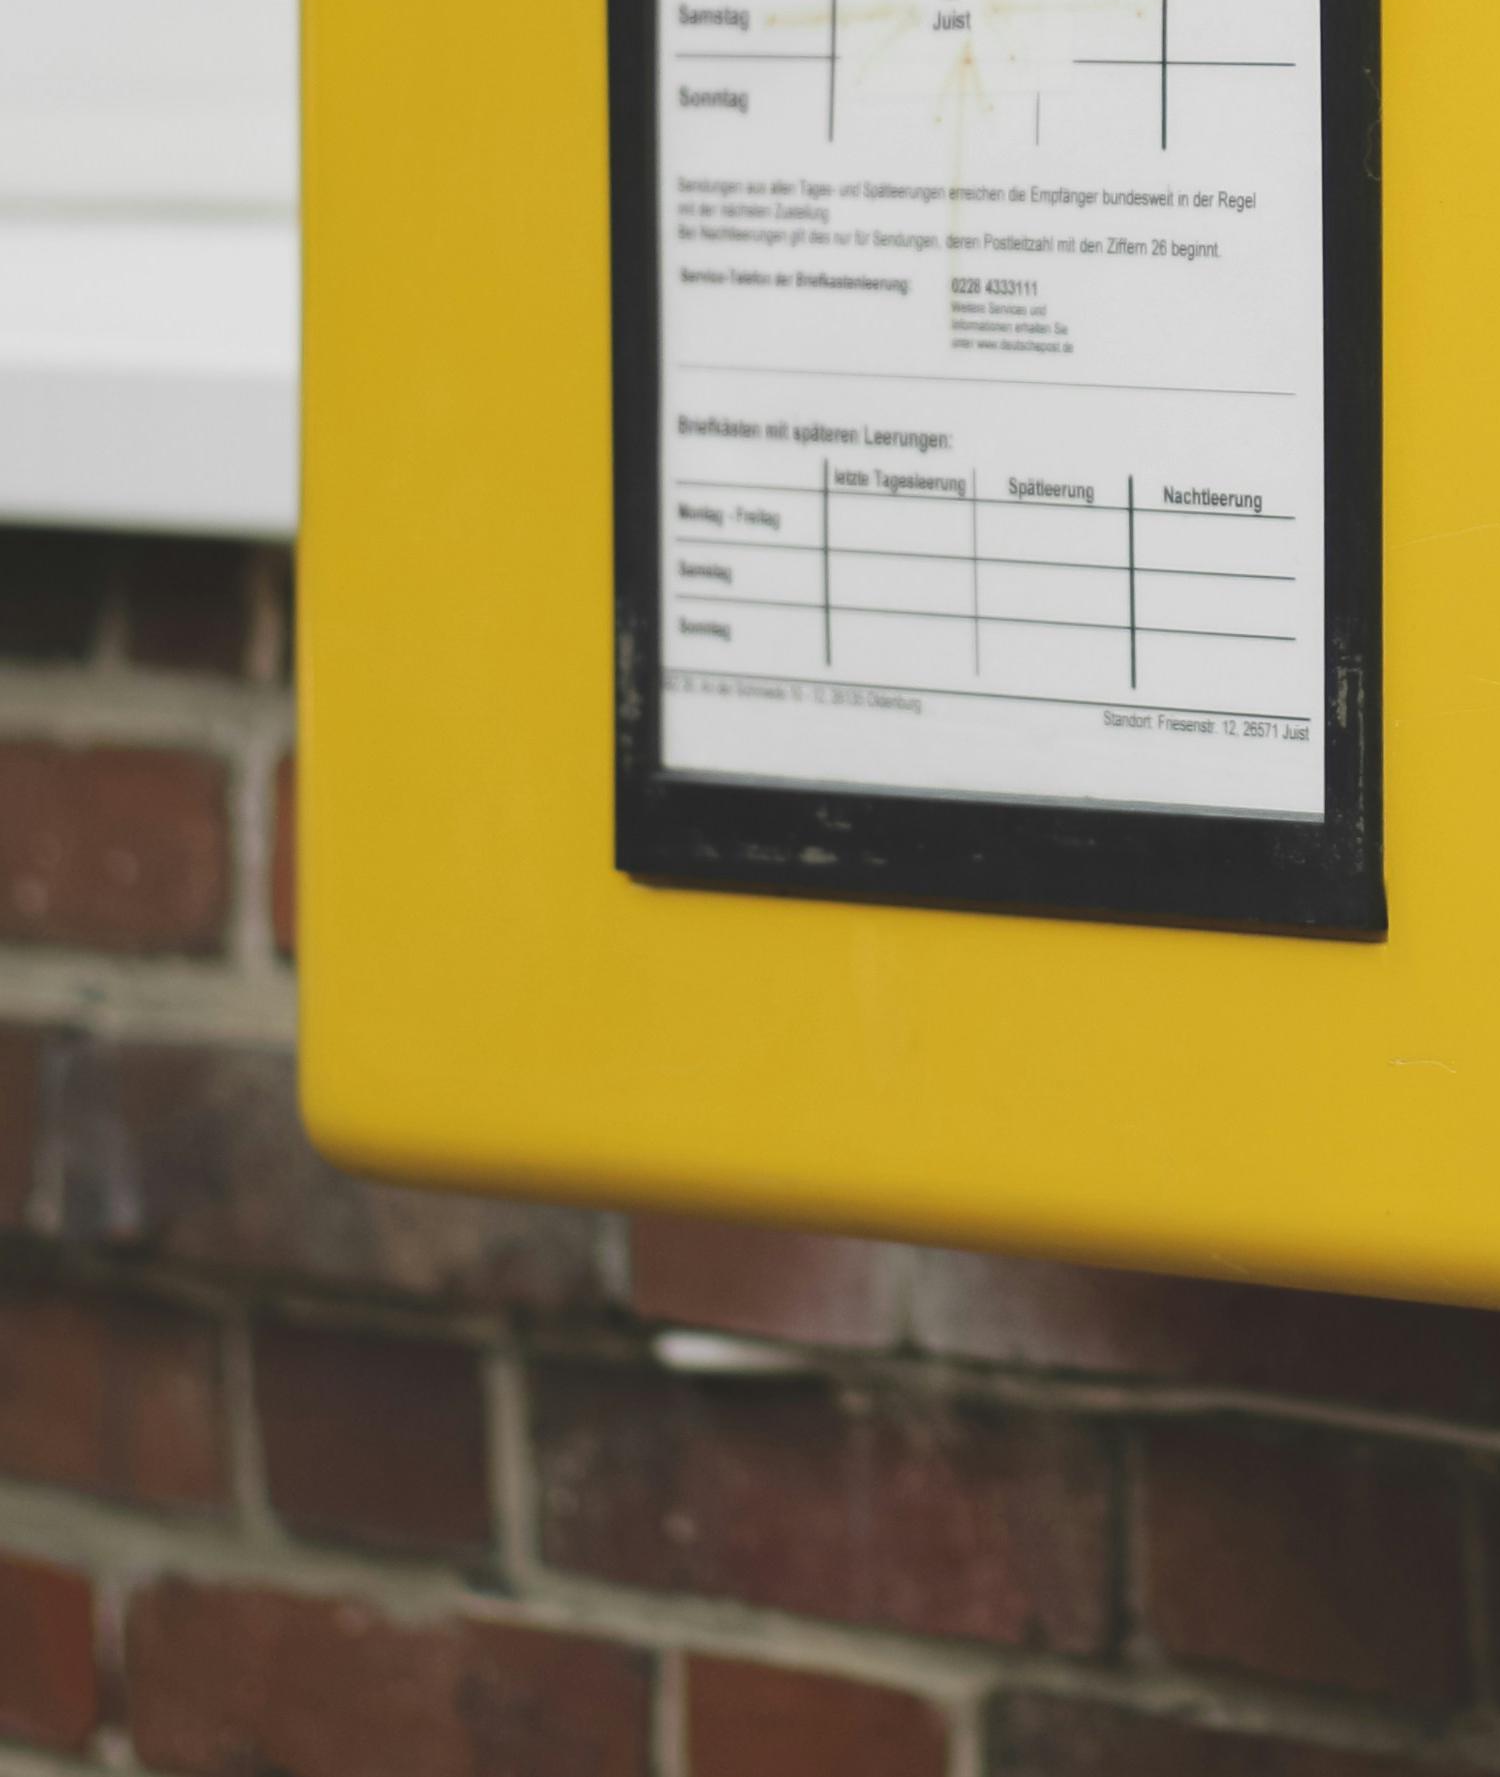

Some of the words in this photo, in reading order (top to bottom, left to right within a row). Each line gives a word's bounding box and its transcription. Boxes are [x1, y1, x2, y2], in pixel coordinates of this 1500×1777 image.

[678, 3, 749, 31] Samstag
[932, 10, 971, 31] Juist
[678, 85, 748, 113] Sonntag
[1008, 187, 1025, 202] die
[1031, 186, 1098, 209] Empfänger
[1103, 188, 1174, 207] bundesweit
[1178, 191, 1189, 207] in
[1193, 191, 1213, 208] der
[1218, 191, 1257, 212] Regel
[946, 232, 981, 249] deren
[984, 234, 1054, 253] Postleitzahl
[1058, 236, 1076, 254] mit
[1080, 237, 1103, 255] den
[1107, 237, 1148, 255] Ziffern
[1151, 240, 1168, 256] 26
[1171, 240, 1221, 261] beginnt.
[951, 277, 981, 294] 0228
[985, 279, 1038, 296] 4333111
[765, 421, 788, 441] mit
[793, 422, 857, 446] späteren
[864, 424, 953, 453] Leerungen:
[834, 467, 869, 487] letzte
[874, 470, 967, 497] Tagesleerung
[1008, 477, 1095, 503] Spätleerung
[1163, 486, 1263, 513] Nachtleerung
[1243, 721, 1279, 739] 26571
[1281, 724, 1311, 742] Juist
